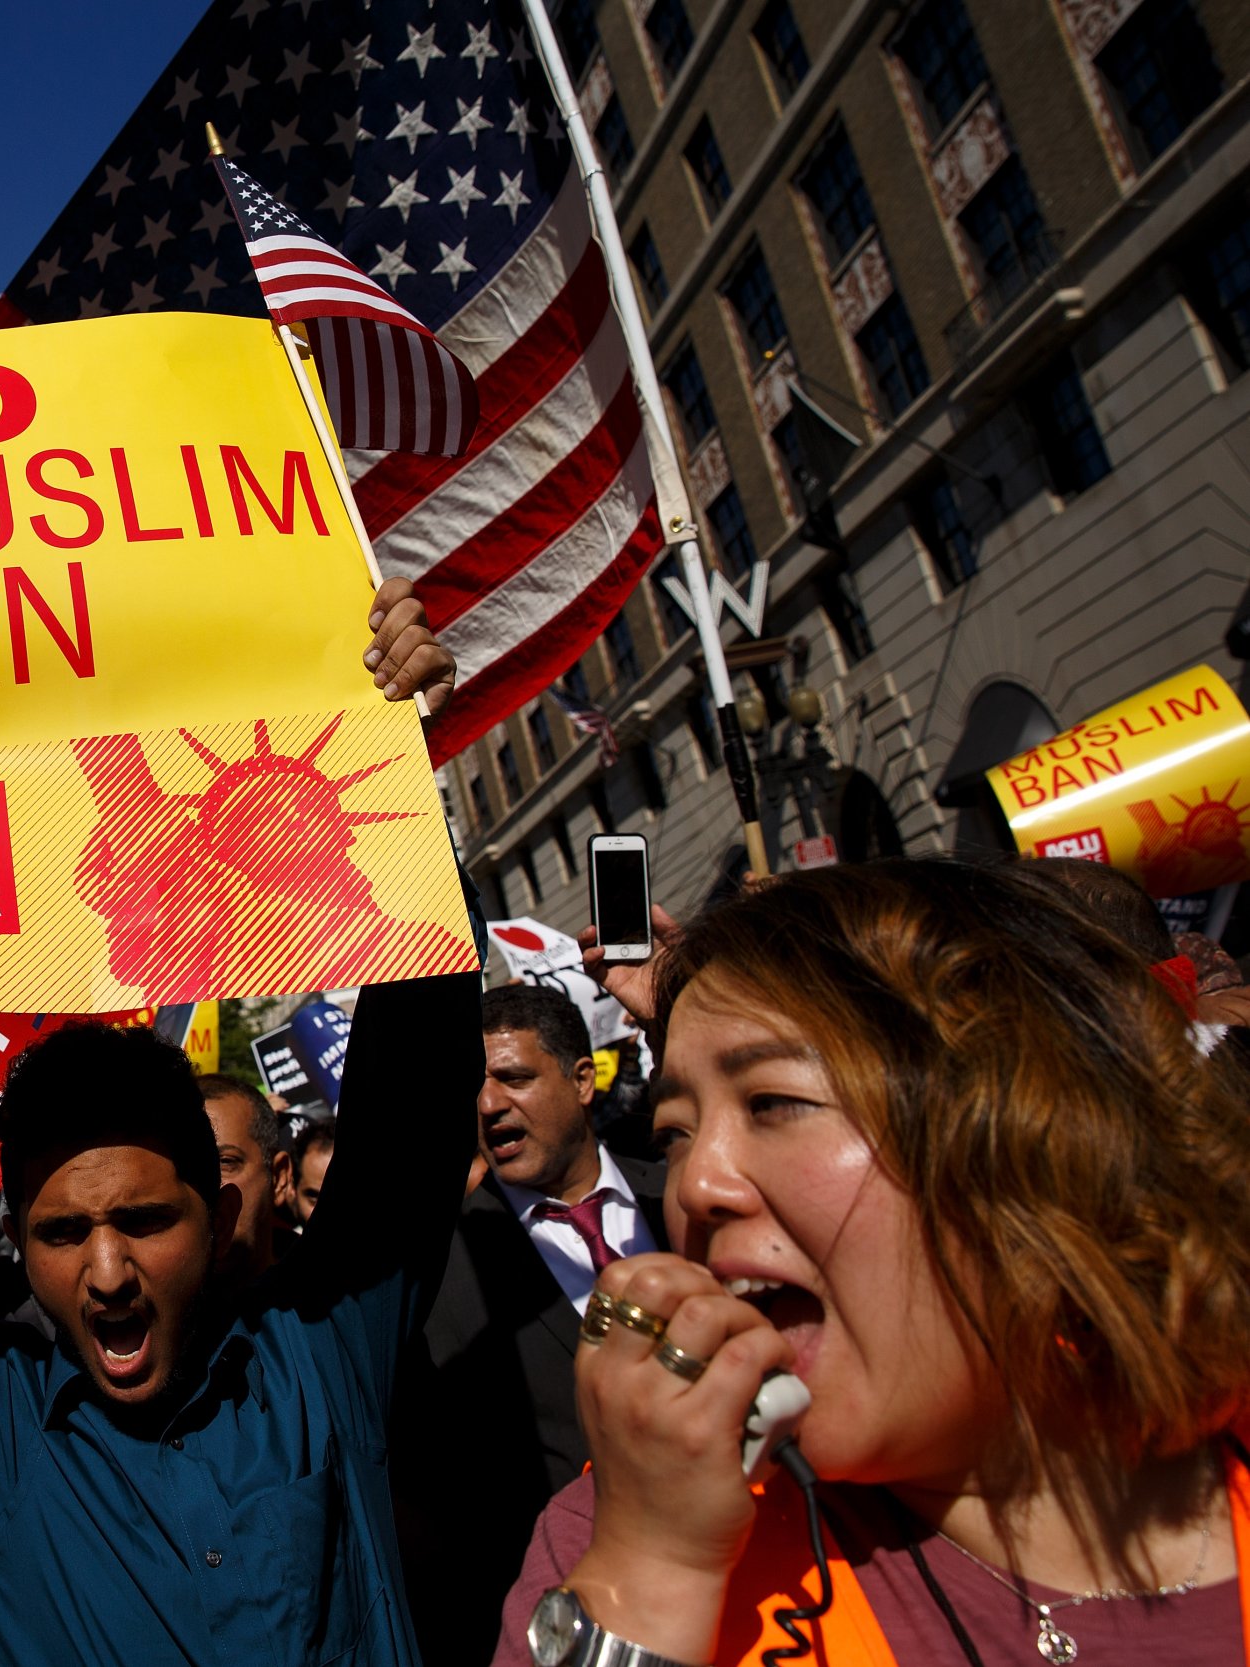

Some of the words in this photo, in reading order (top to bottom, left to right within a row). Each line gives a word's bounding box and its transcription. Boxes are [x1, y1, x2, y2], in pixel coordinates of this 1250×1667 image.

[660, 560, 769, 639] W
[1001, 687, 1220, 778] MUSLIM
[1009, 748, 1124, 809] BAN
